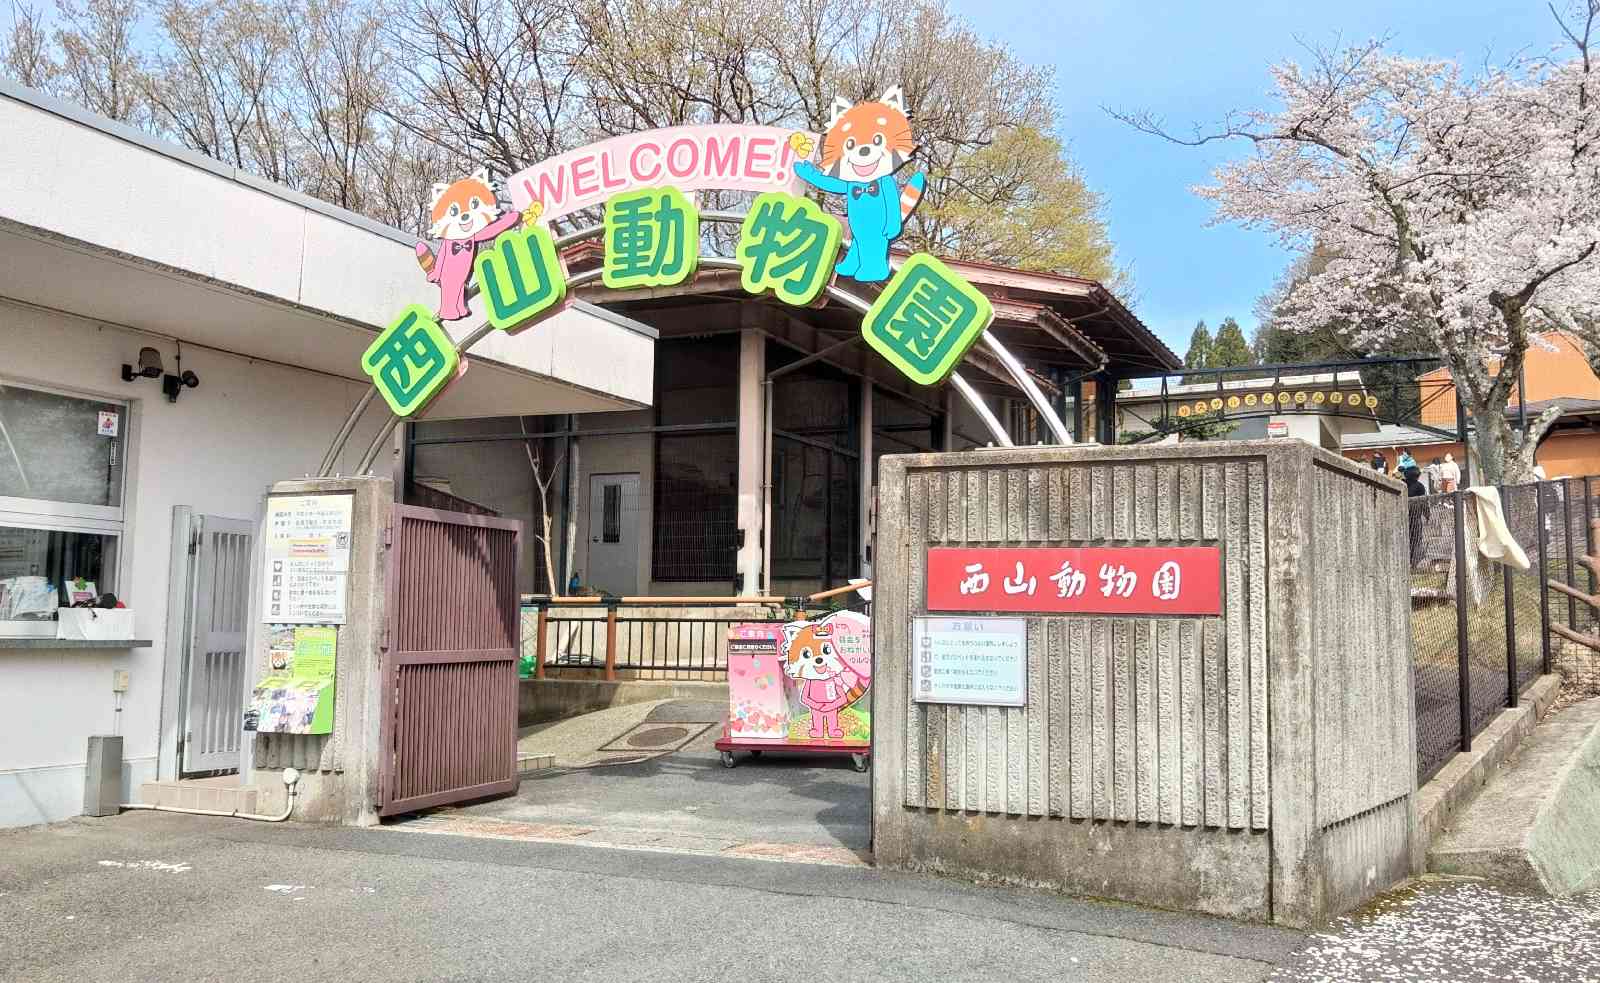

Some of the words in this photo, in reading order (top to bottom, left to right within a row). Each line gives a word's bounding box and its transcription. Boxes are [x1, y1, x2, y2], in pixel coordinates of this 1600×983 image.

[523, 136, 790, 208] WELCOME!
[368, 194, 978, 408] 西山動物園
[959, 559, 1182, 601] 西山動物園
